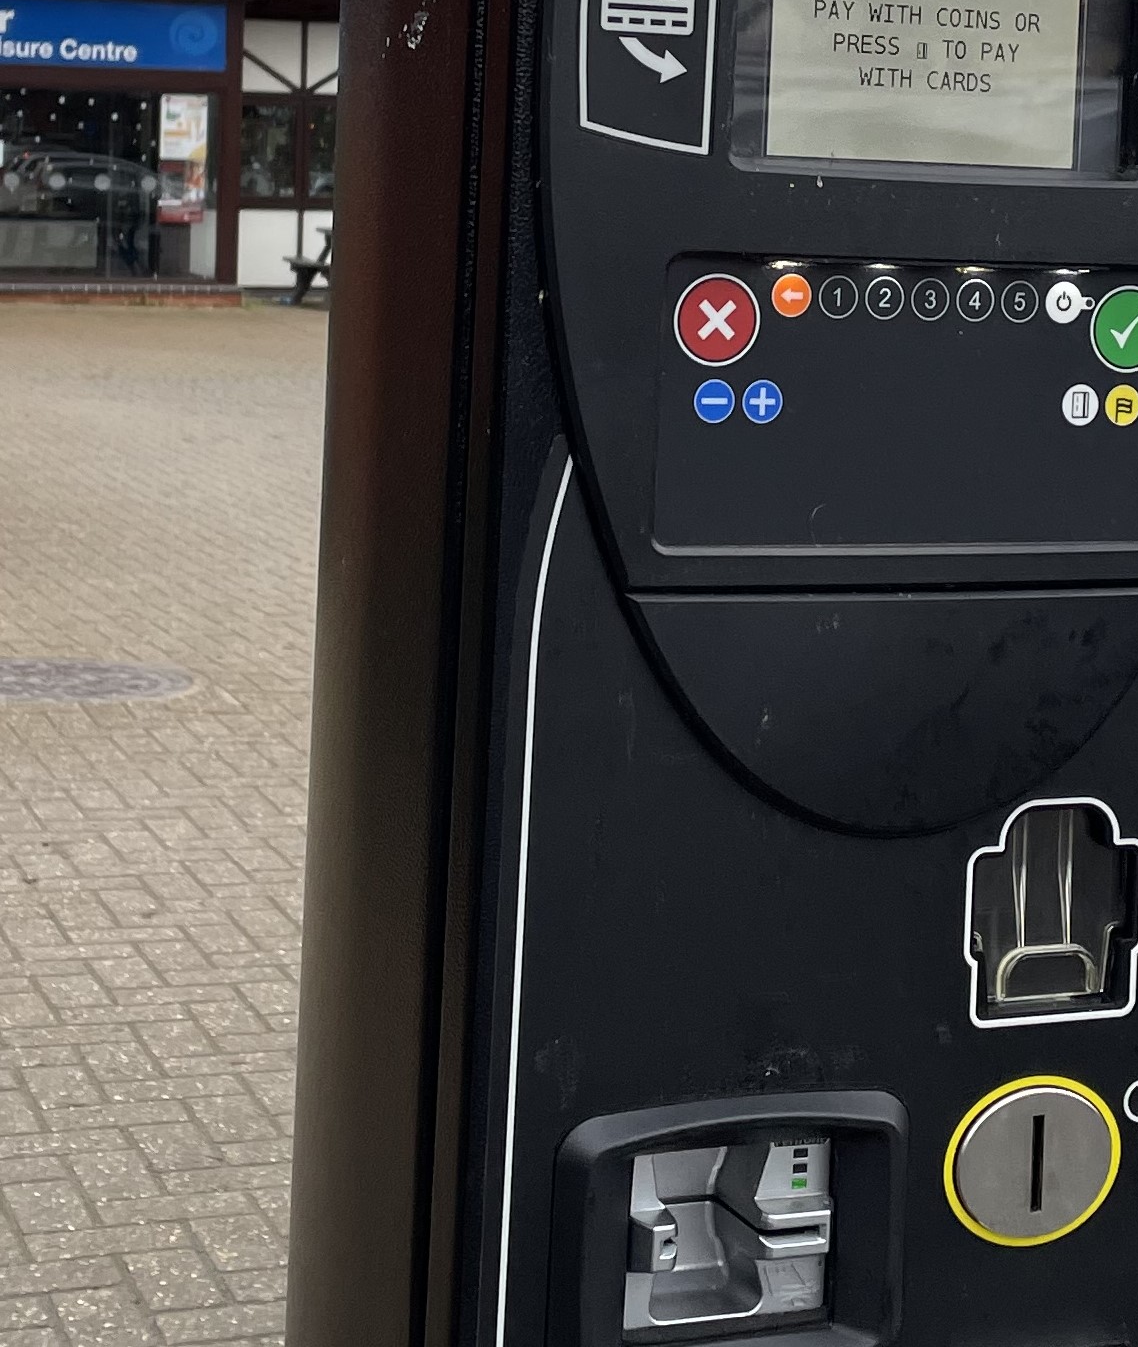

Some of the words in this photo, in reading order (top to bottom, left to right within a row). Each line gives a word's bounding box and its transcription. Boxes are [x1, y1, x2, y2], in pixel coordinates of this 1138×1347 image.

[868, 2, 922, 25] WITH
[936, 7, 1001, 30] COINS
[1014, 12, 1040, 33] OR
[60, 38, 138, 63] Centre
[833, 32, 900, 56] PRESS
[942, 39, 967, 60] TO
[980, 42, 1020, 63] PAY
[858, 66, 912, 89] WITH
[926, 70, 992, 93] CARDS
[833, 287, 842, 307] 1
[879, 289, 891, 308] 2
[925, 291, 937, 310] 3
[969, 292, 981, 311] 4
[1014, 292, 1026, 311] 5
